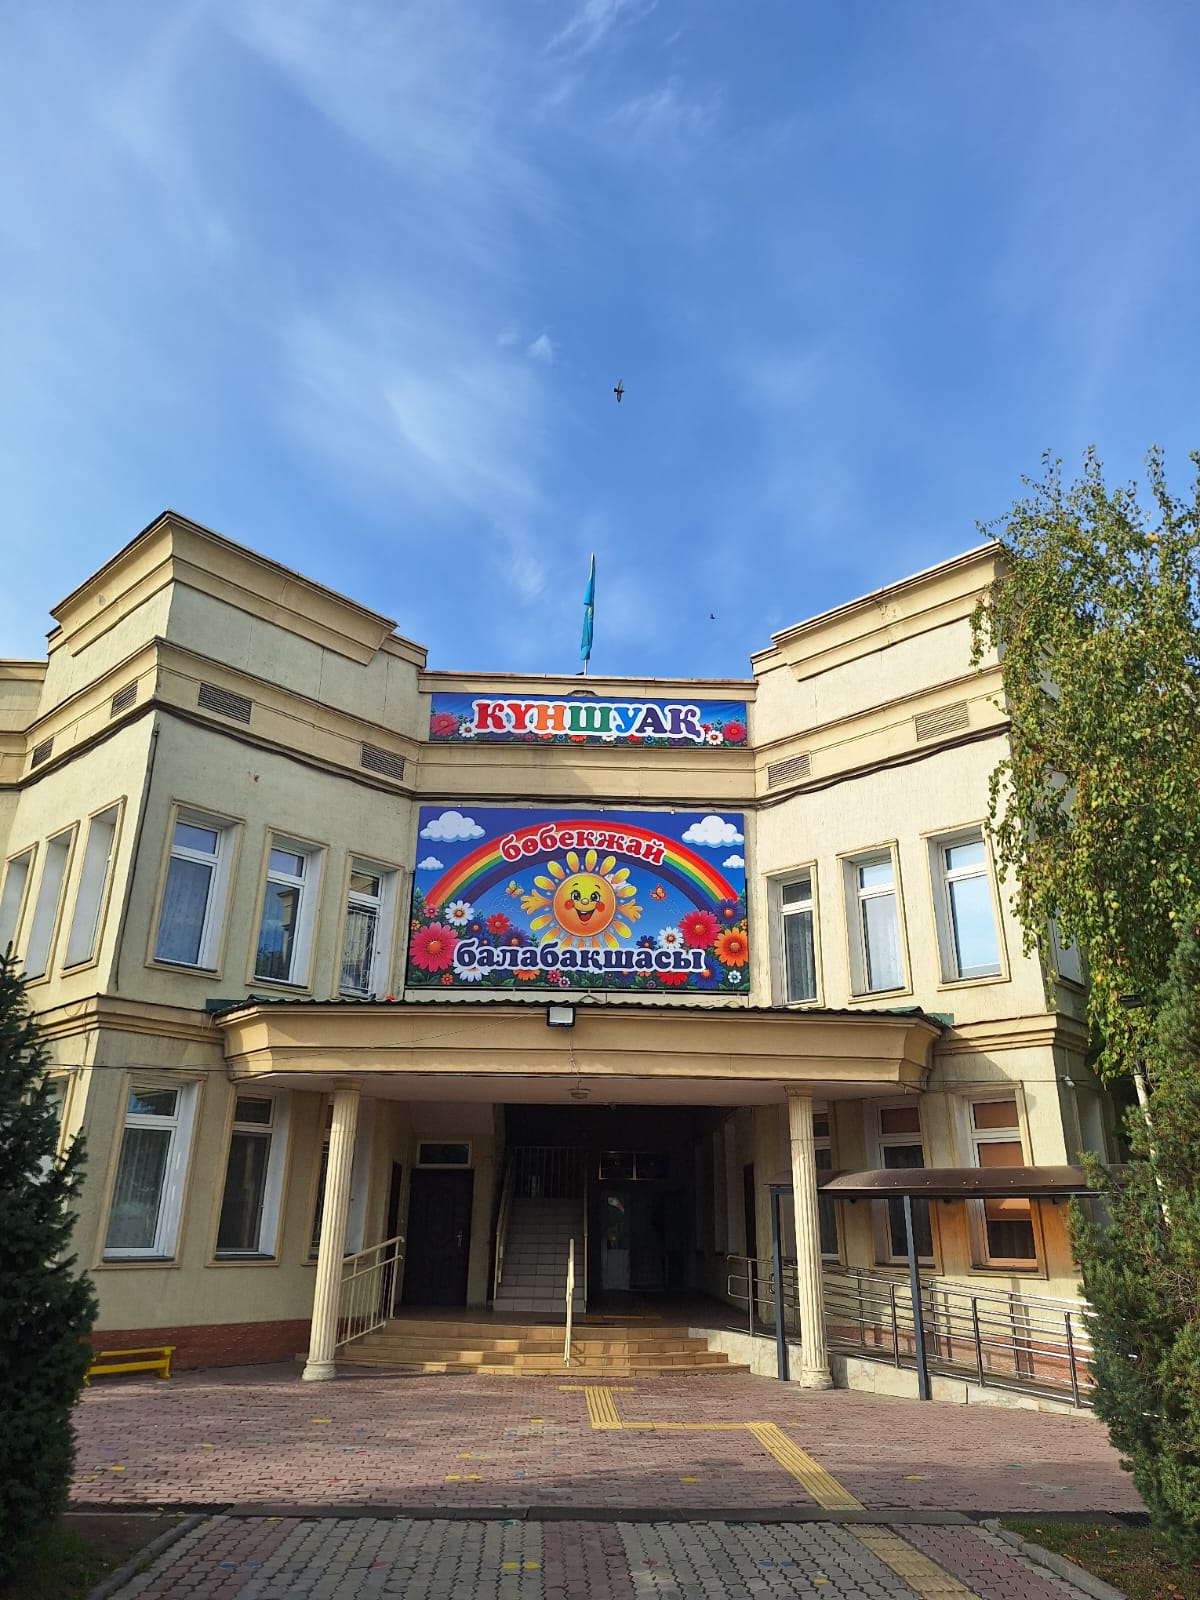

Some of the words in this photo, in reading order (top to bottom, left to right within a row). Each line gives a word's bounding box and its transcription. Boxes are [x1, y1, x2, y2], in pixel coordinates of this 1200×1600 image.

[474, 702, 702, 739] КҮНШУАҚ
[500, 825, 666, 864] бөбекжай
[456, 939, 706, 971] балабақшасы
